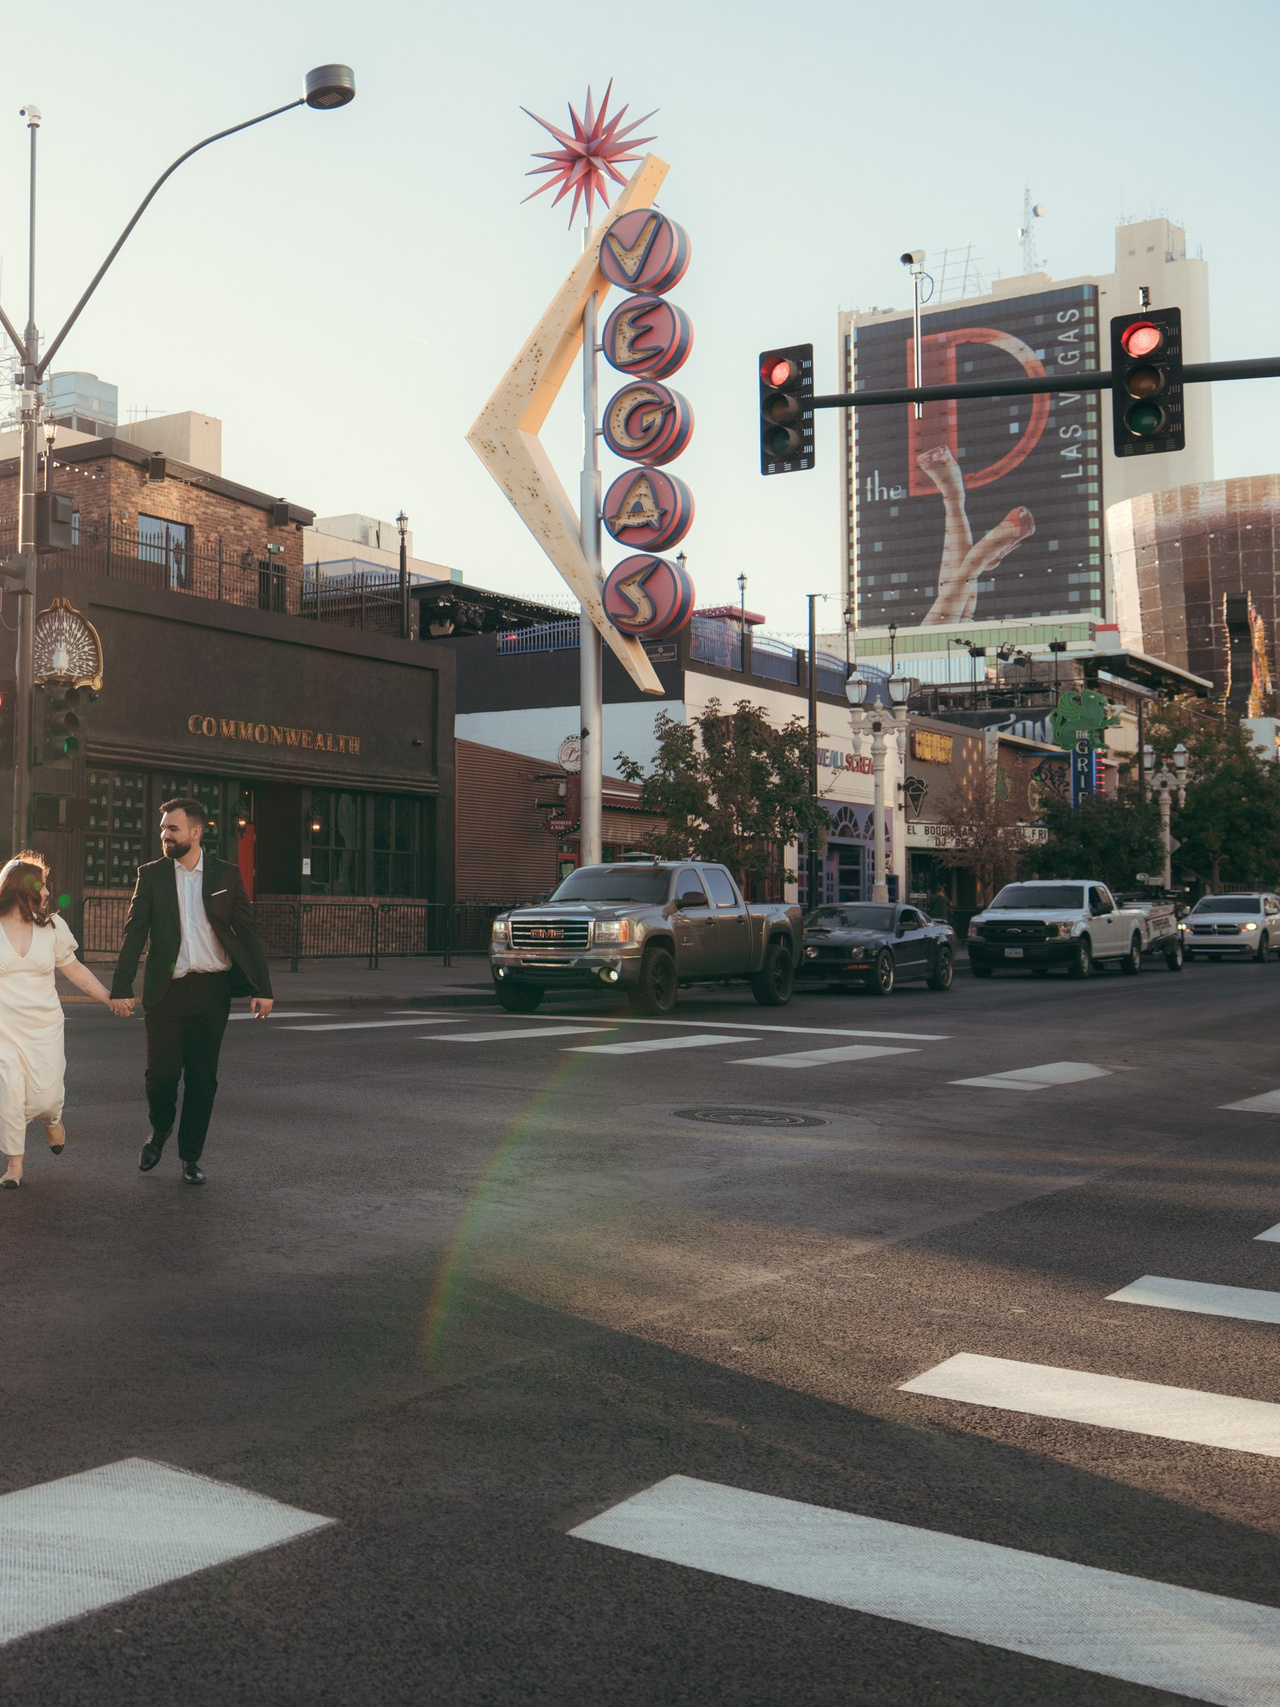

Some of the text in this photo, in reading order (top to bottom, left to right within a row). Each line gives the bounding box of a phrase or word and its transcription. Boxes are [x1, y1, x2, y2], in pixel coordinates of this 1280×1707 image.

[865, 327, 1051, 503] the D
[1056, 309, 1084, 479] LAS VGAS
[605, 211, 674, 626] VEGAS
[187, 713, 362, 756] COMMONWEALTH
[1075, 729, 1090, 739] THE
[907, 825, 917, 834] EL
[530, 928, 564, 938] GMC
